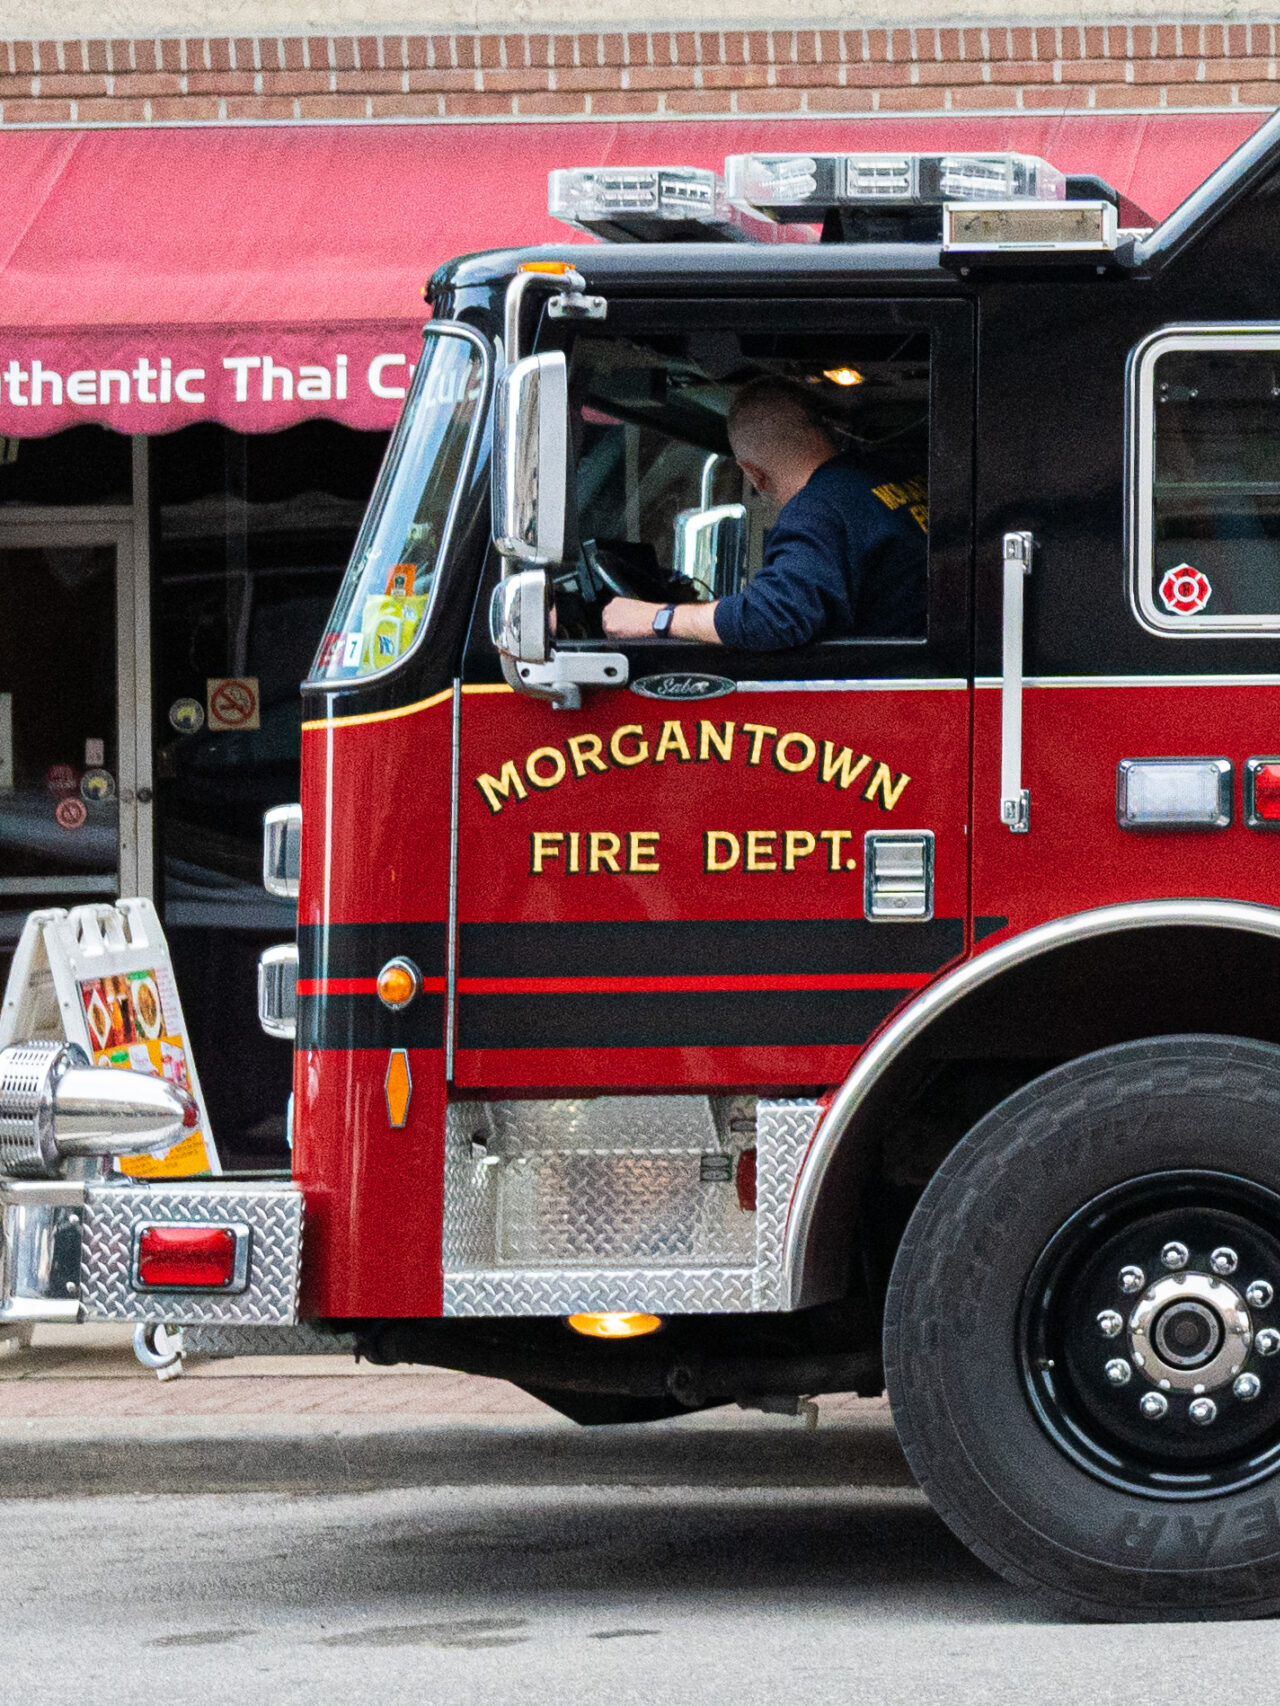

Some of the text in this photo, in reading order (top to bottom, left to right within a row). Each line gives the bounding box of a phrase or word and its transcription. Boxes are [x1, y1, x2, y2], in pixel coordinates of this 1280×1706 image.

[0, 356, 205, 406] thentic
[223, 353, 348, 402] Thai
[473, 719, 912, 815] MORGANTOWN
[530, 829, 858, 875] FIRE DEPT.
